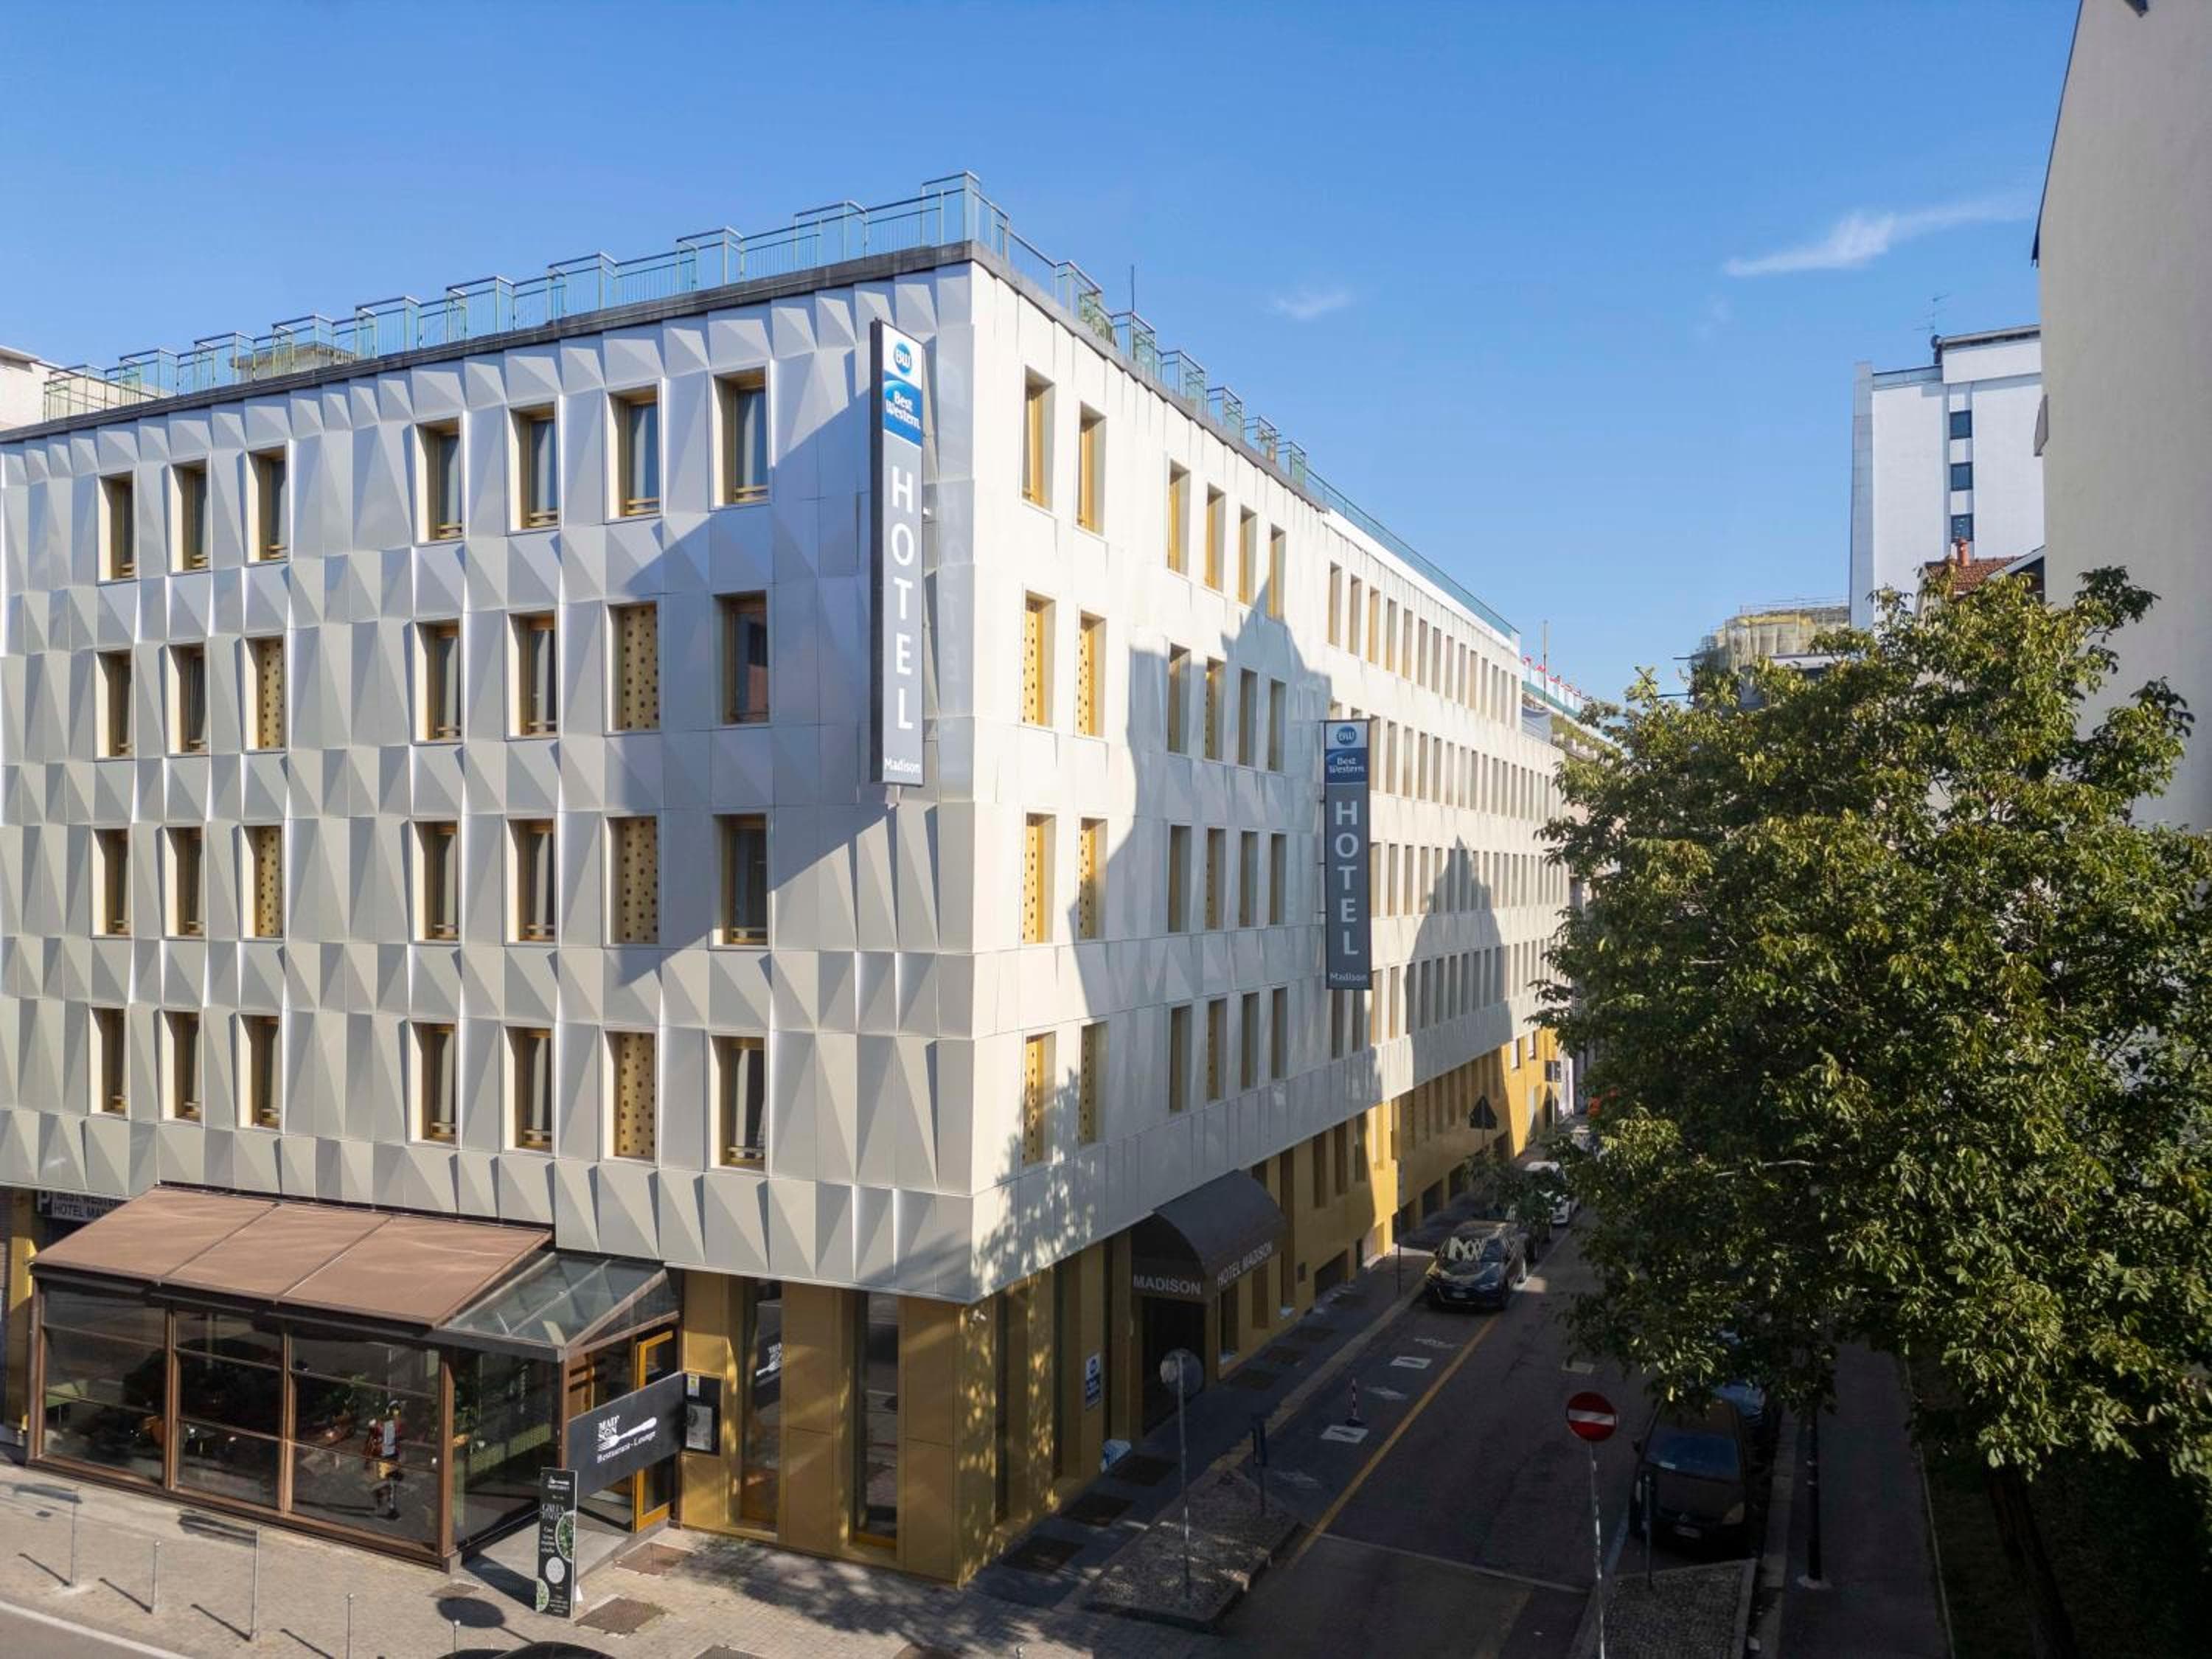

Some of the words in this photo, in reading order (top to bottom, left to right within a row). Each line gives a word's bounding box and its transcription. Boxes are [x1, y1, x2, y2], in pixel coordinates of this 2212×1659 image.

[893, 390, 913, 412] Best
[891, 466, 915, 730] HOTEL
[884, 757, 921, 775] Madison
[1335, 800, 1359, 956] HOTEL
[1329, 972, 1368, 981] Madison
[54, 1203, 85, 1217] HOTEL
[1133, 1274, 1201, 1295] MADISON
[1217, 1262, 1241, 1287] HOTEL
